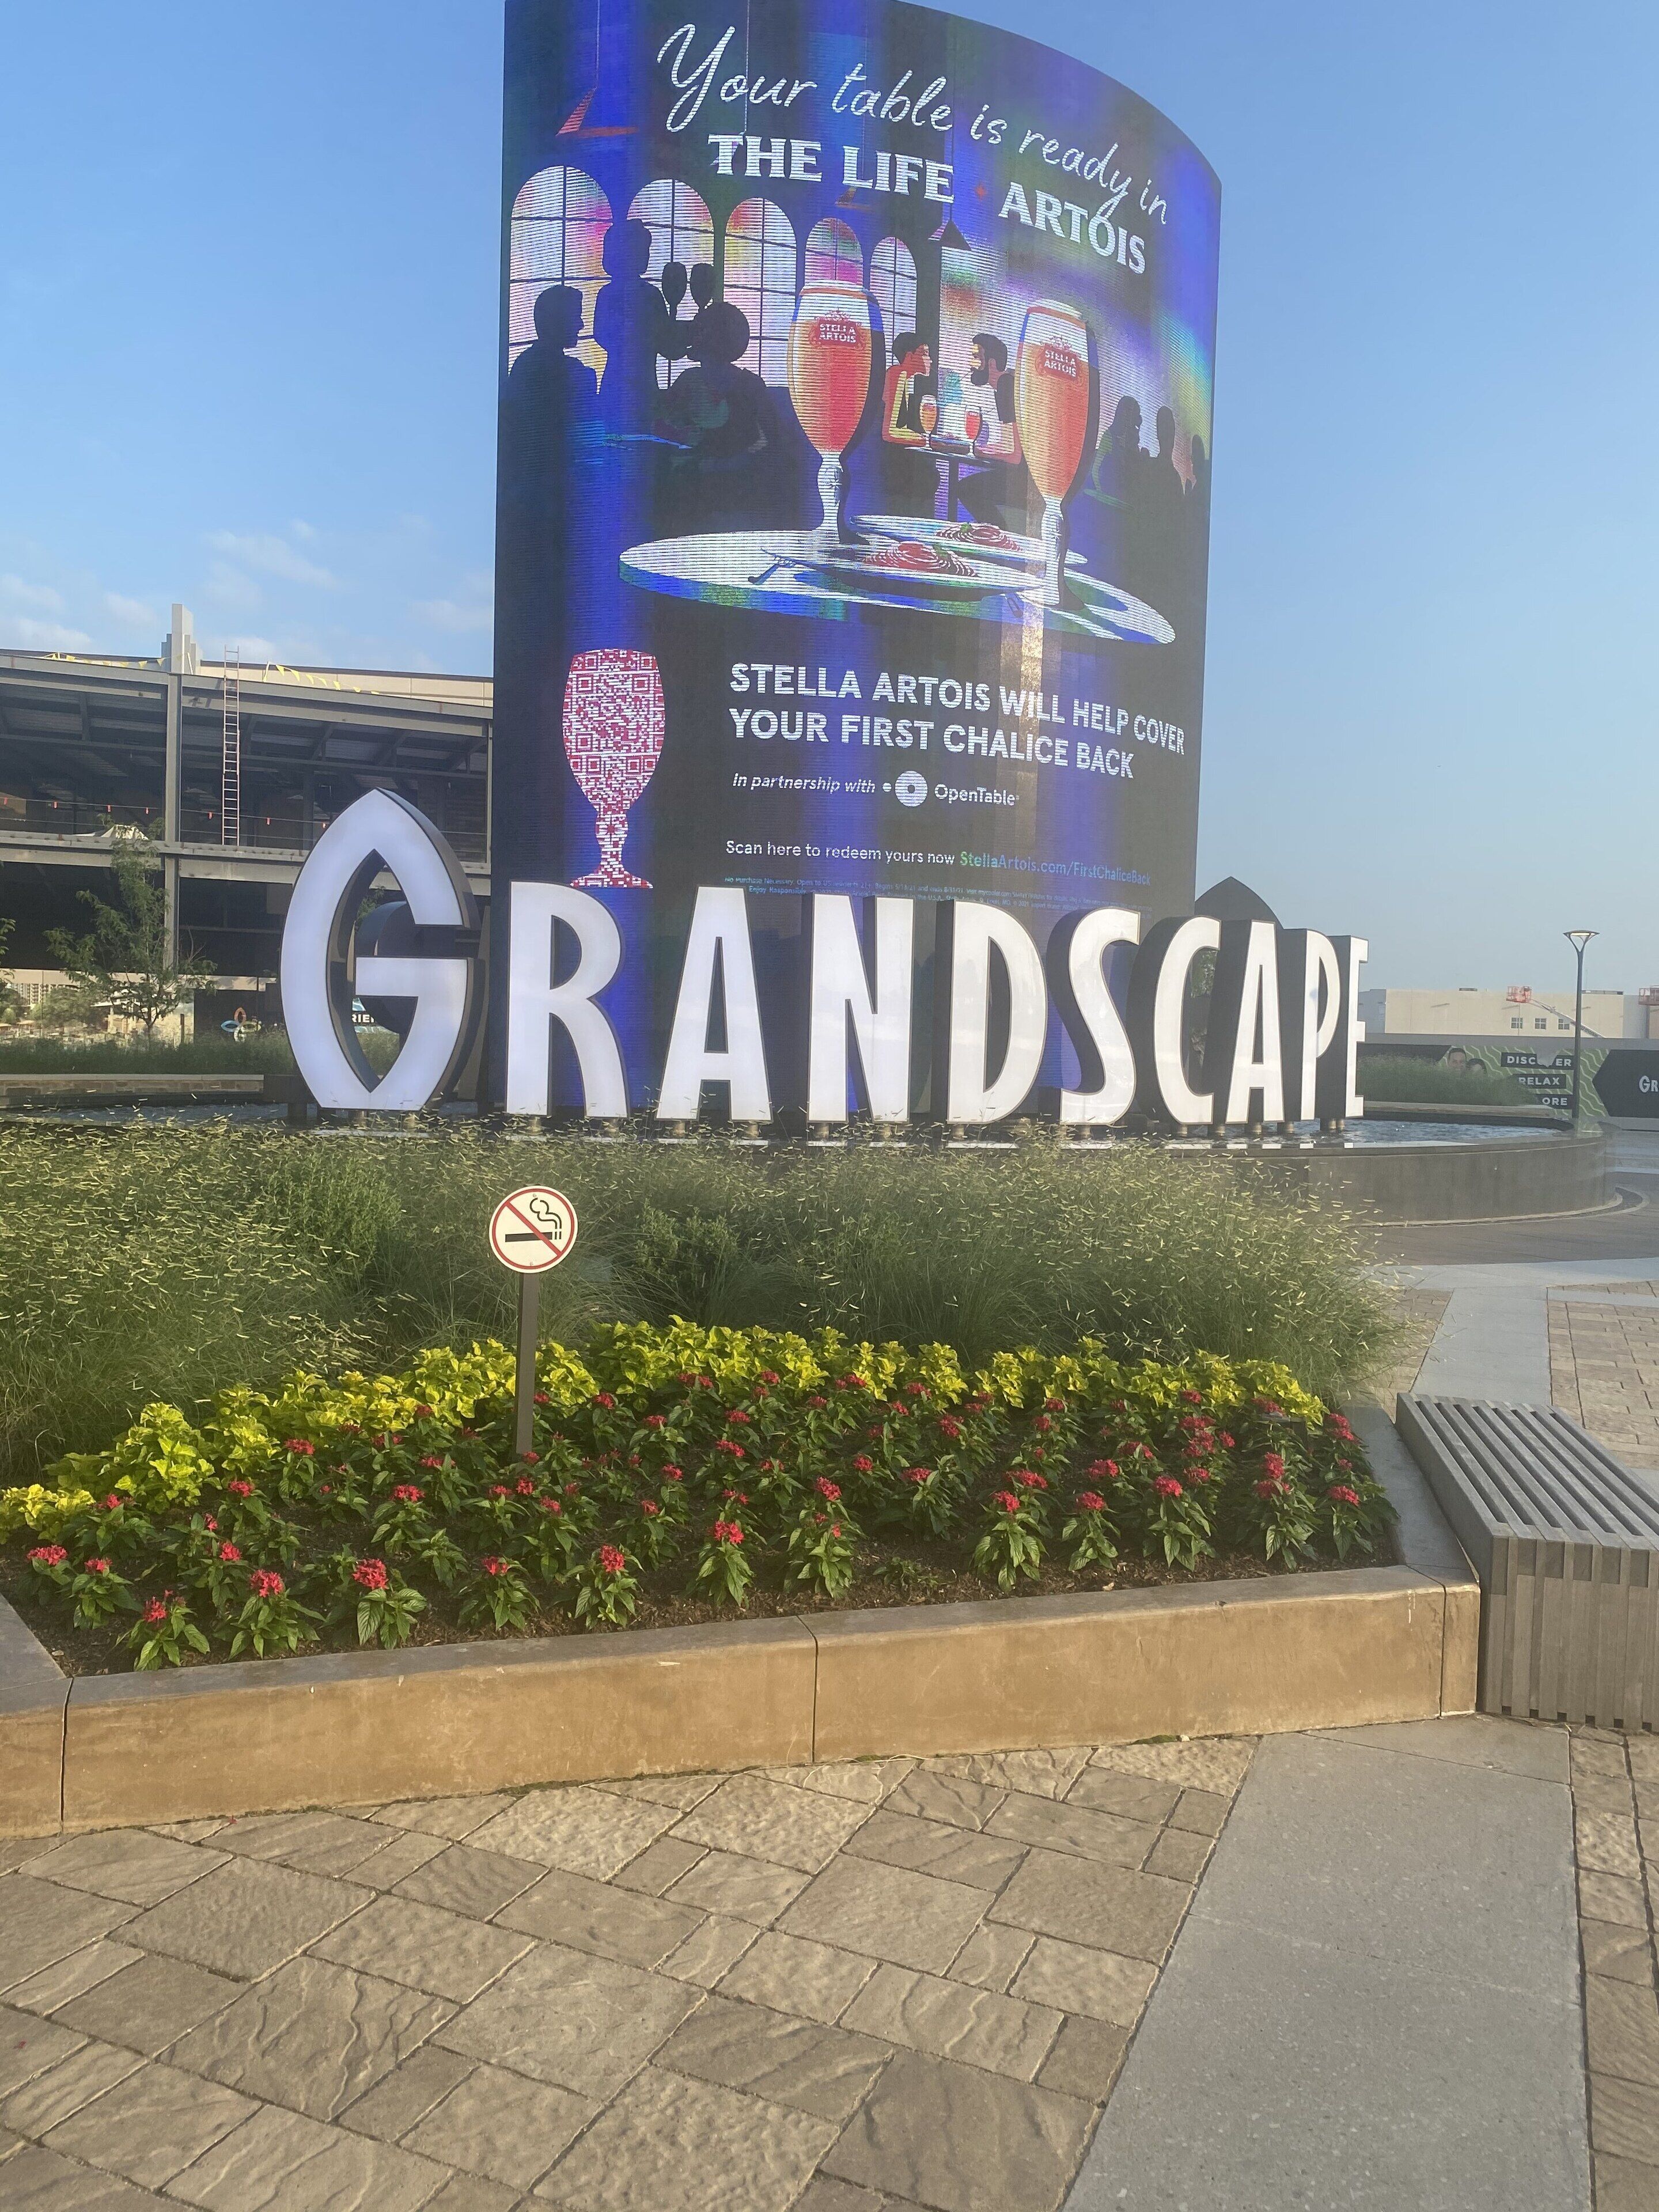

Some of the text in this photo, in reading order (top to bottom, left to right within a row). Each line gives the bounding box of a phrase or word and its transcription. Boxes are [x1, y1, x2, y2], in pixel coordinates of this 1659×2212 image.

[657, 23, 1168, 225] Your table is ready in
[708, 133, 1147, 275] THE LIFE ARTOIS
[819, 332, 857, 343] ARTOIS
[729, 662, 1186, 755] STELLA ARTOIS WILL HELP COVER
[729, 707, 1135, 779] YOUR FIRST CHALICE BACK
[733, 772, 876, 794] In partnership with
[934, 783, 1016, 806] OpenTable
[726, 840, 1151, 887] Scan here to redeem yours now StellaArtois.com/FirstChaliceBack
[281, 787, 1369, 1125] GRANDSCAPE
[1506, 1055, 1572, 1067] DISCER
[1518, 1077, 1560, 1086] RELAX
